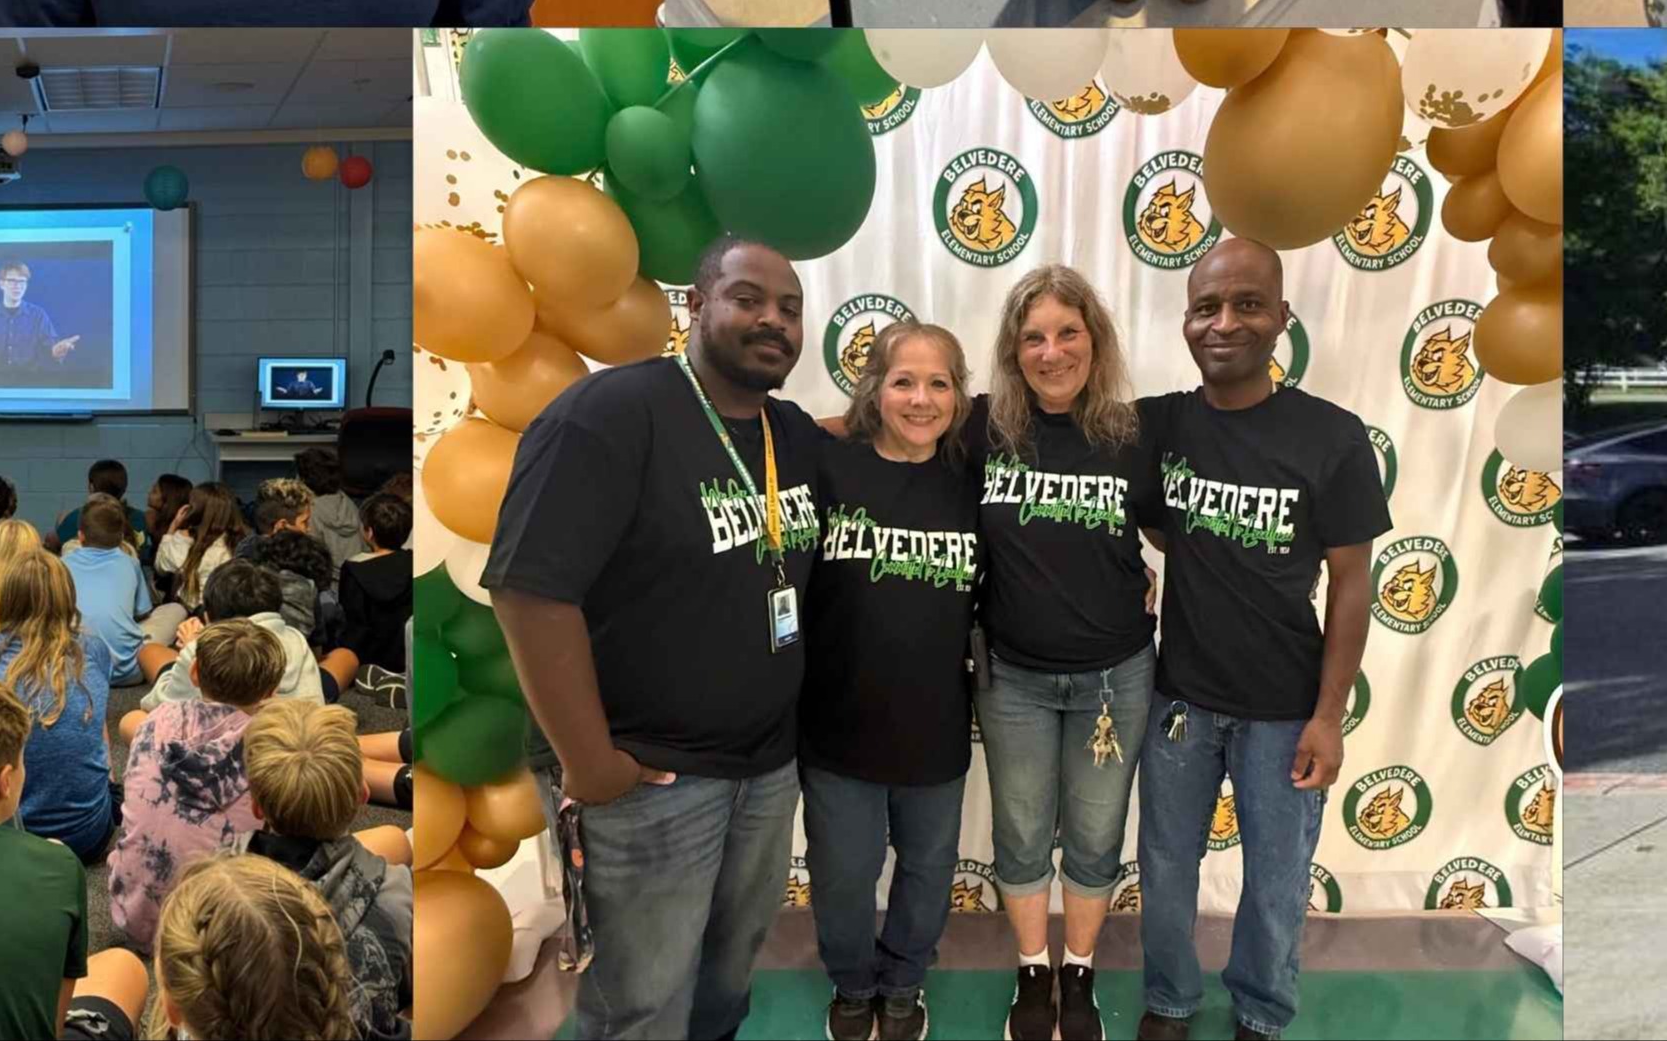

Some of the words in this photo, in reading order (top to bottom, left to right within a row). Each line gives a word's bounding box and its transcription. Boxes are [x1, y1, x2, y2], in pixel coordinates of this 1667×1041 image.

[882, 98, 916, 130] SCHOOL
[1031, 100, 1082, 137] ELEMENTARY
[1086, 99, 1119, 133] SCHOOL
[943, 149, 1026, 184] BELVEDERE
[1134, 152, 1203, 188] BELVEDE
[940, 228, 995, 266] ELEMENTARY
[997, 232, 1029, 264] SCHOOL
[1129, 233, 1182, 266] ELEMENTARY
[1184, 234, 1217, 264] SCHOOL
[1335, 233, 1383, 268] ELEMENTARY
[1388, 233, 1423, 265] SCHOOL
[1413, 300, 1483, 333] BELVEDE
[1379, 538, 1448, 565] BELVEDERE
[1464, 658, 1520, 683] BELVED
[1355, 766, 1422, 793] BELVEDERE
[1391, 824, 1422, 846] SCHOOL
[1433, 858, 1501, 884] BELVEDERE
